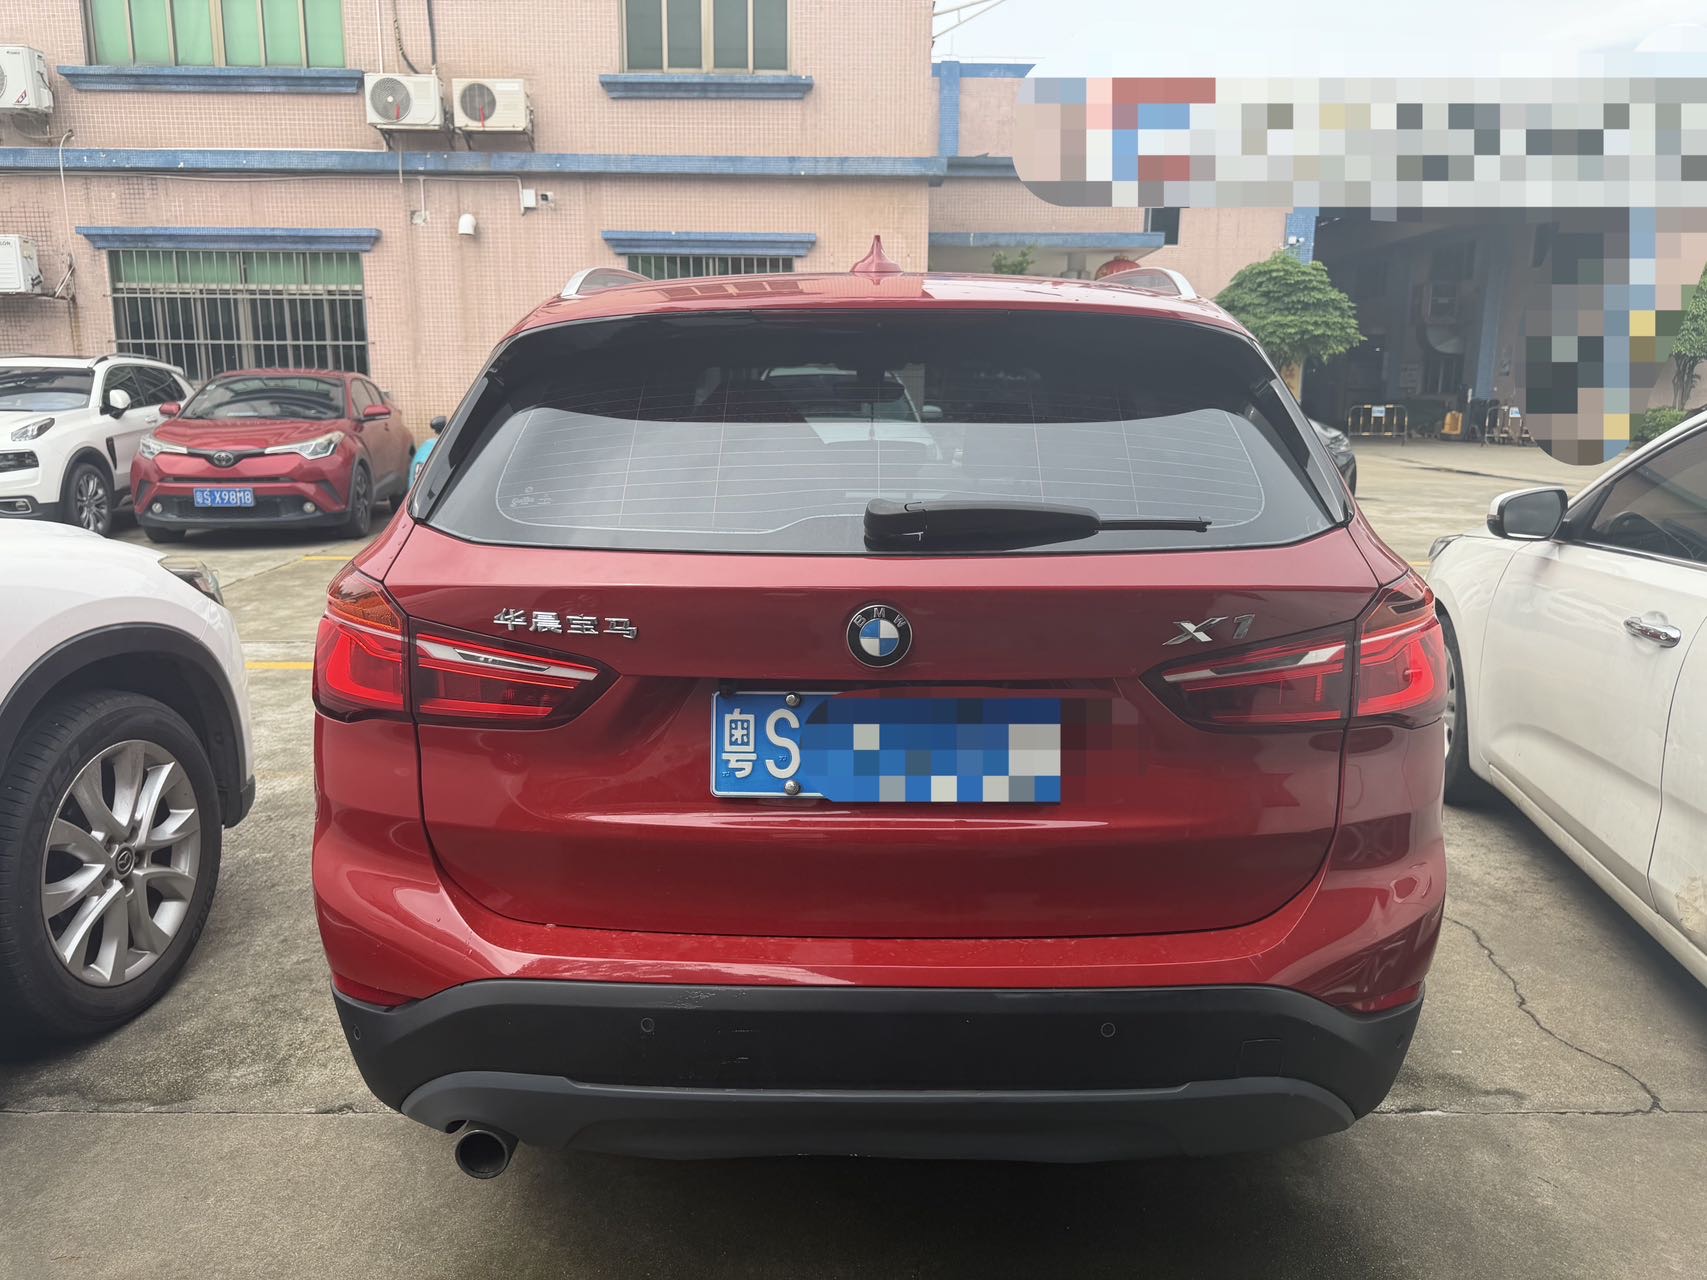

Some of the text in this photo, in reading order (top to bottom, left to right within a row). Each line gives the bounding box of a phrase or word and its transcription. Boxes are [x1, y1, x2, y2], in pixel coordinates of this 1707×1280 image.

[493, 608, 638, 639] 华晨宝马
[853, 607, 906, 628] BMW
[1162, 614, 1256, 646] X1
